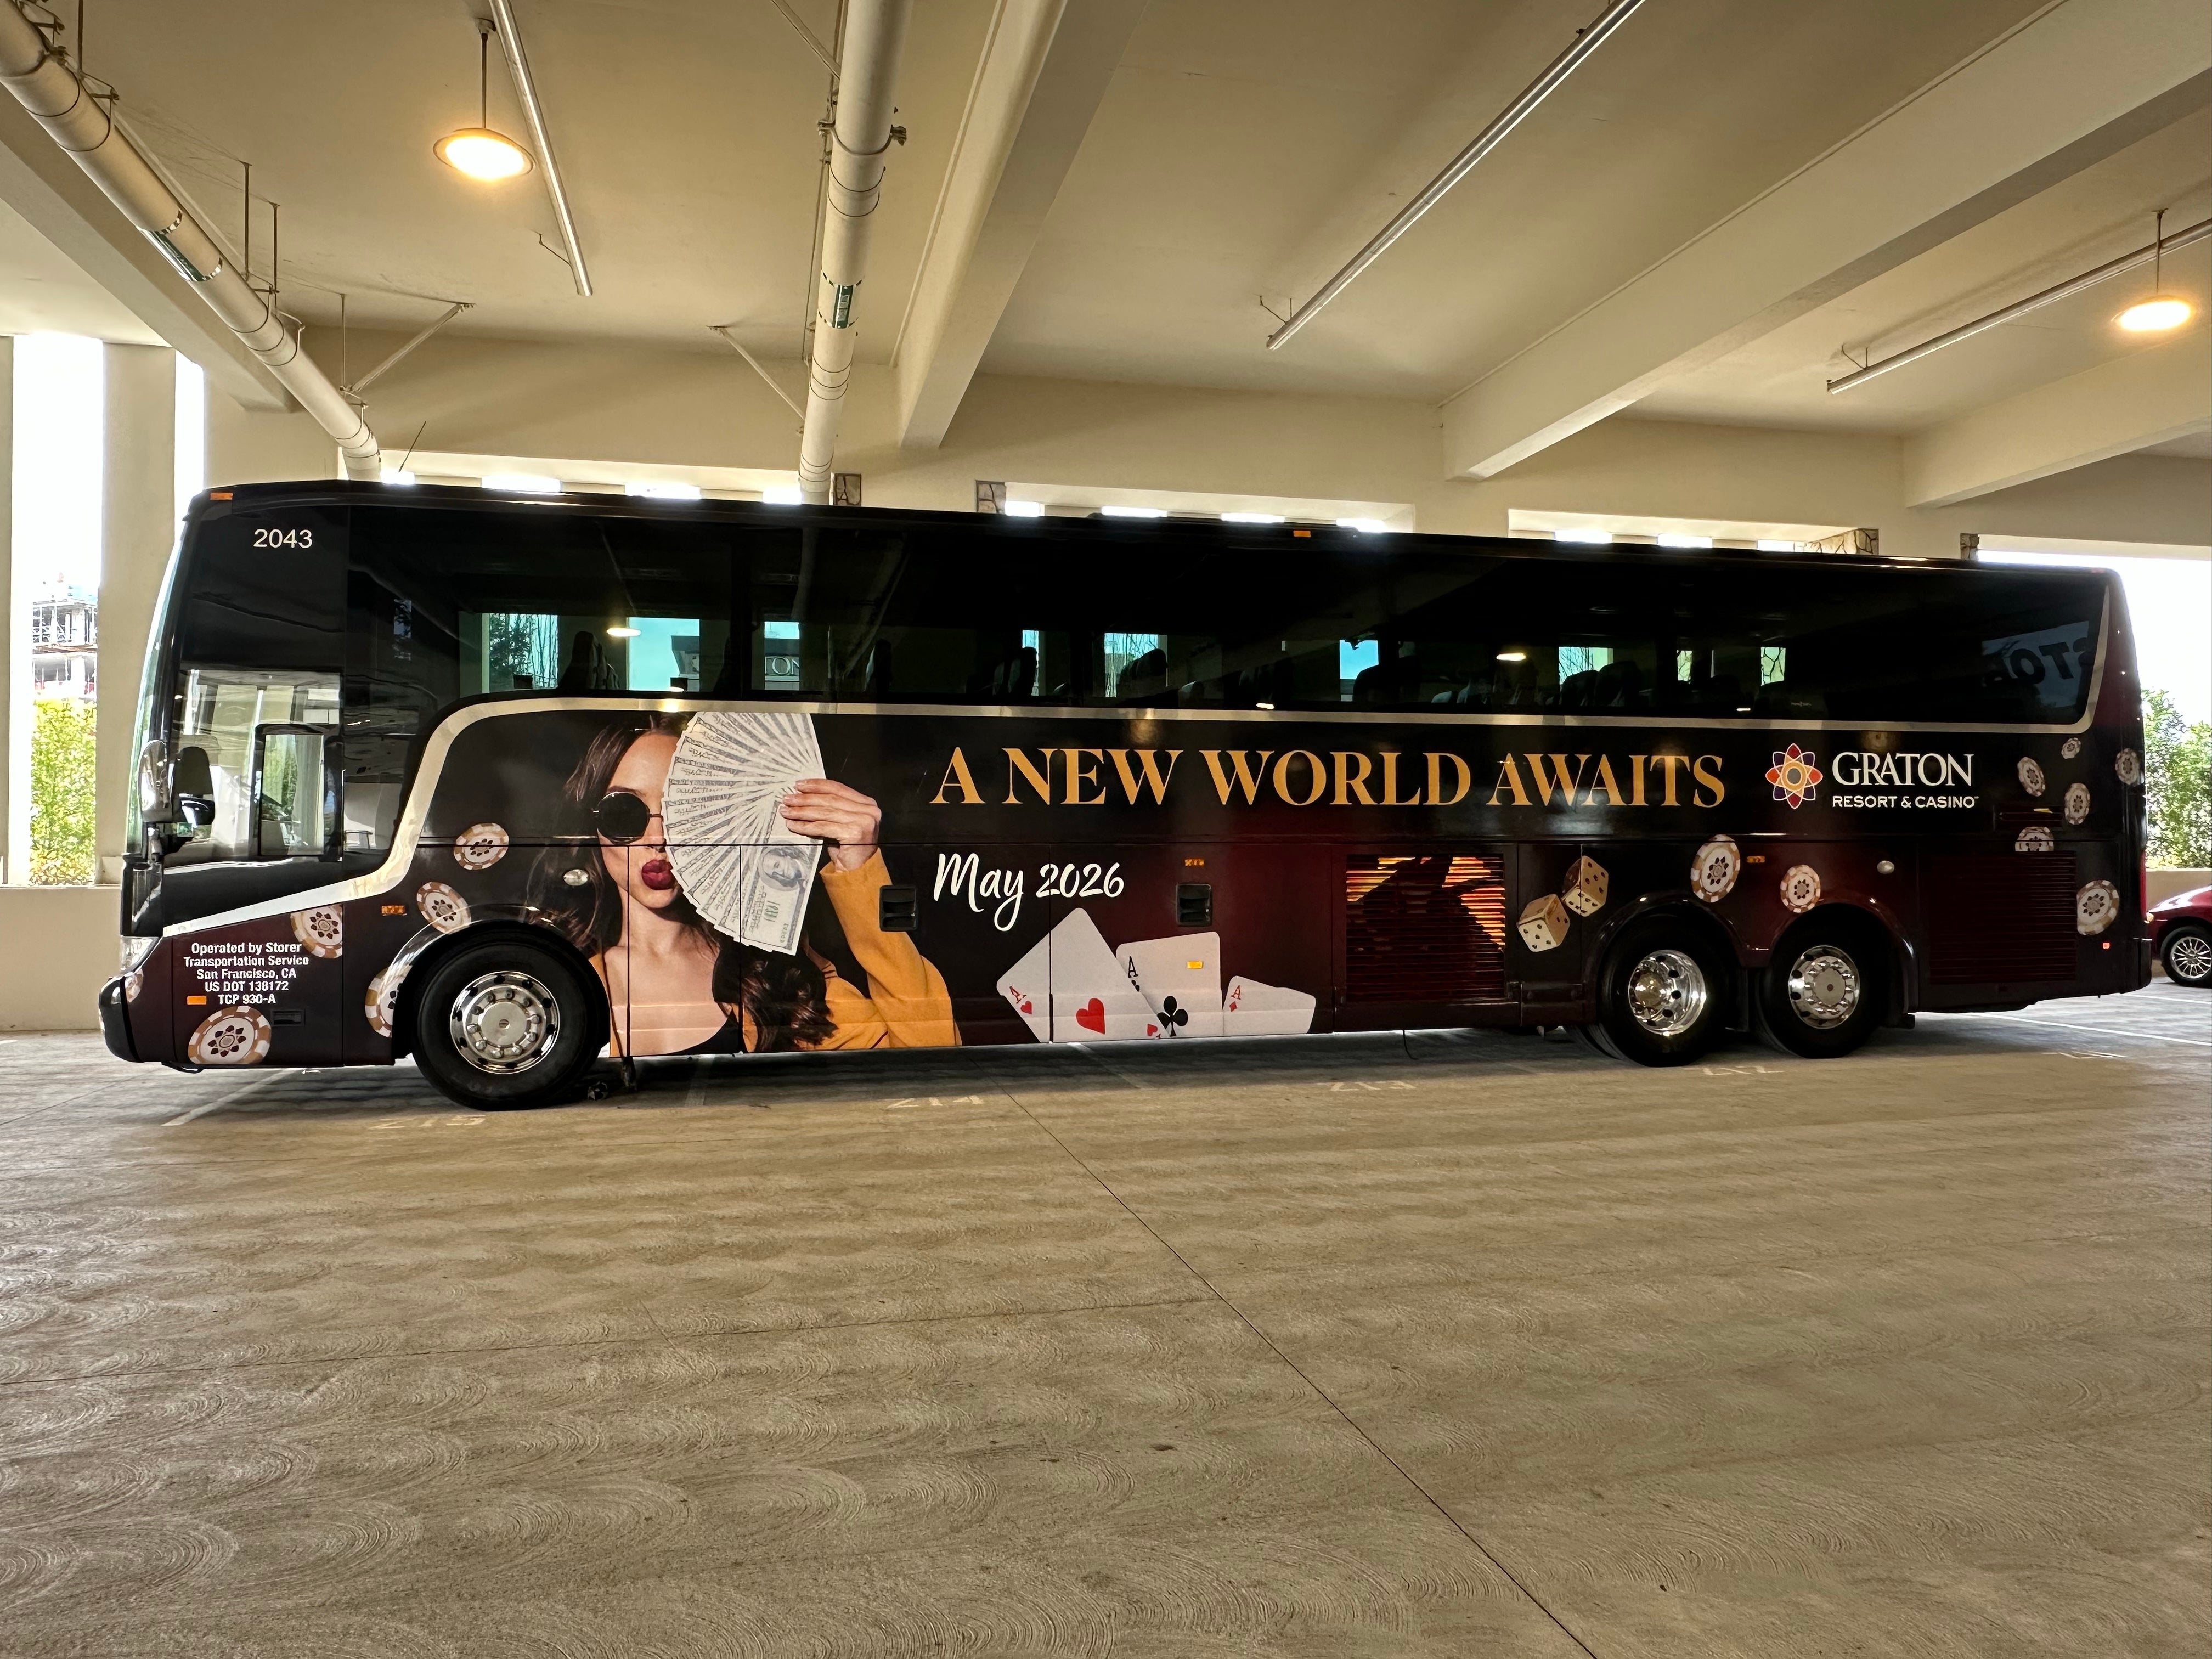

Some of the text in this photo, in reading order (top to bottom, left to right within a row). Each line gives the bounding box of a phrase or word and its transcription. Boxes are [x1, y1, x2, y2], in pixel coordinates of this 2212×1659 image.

[253, 528, 313, 549] 2043
[1832, 752, 1974, 786] GRATON
[929, 747, 1725, 808] A NEW WORLD AWAITS
[1832, 795, 1898, 808] RESORT
[1901, 795, 1911, 808] &
[933, 853, 1125, 932] May 2026
[191, 942, 302, 956] Operated by Storer
[184, 955, 309, 968] Transportation Service
[1128, 956, 1139, 978] A
[196, 968, 297, 980] San Francisco, CA
[205, 981, 289, 992] US DOT 138172
[1231, 985, 1242, 1000] A
[218, 994, 276, 1005] TCP 930-A
